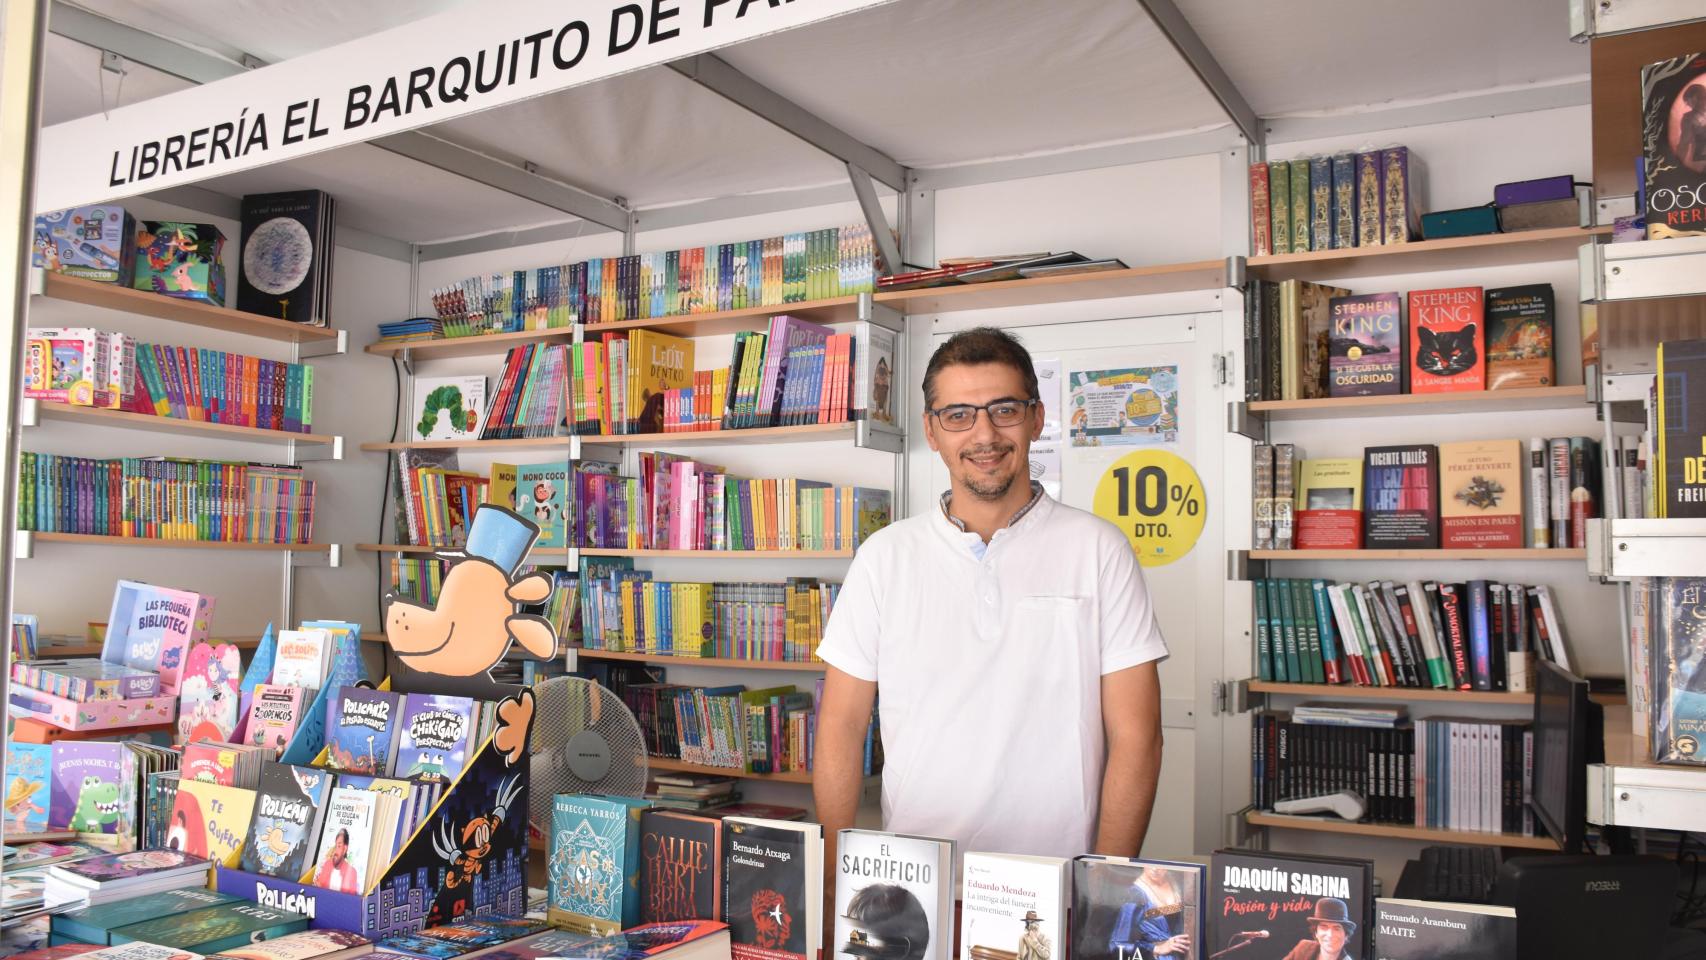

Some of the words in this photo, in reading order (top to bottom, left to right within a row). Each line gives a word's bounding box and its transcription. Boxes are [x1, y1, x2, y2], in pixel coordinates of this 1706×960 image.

[109, 107, 269, 188] LIBRERÍA
[281, 98, 329, 147] EL
[343, 20, 590, 132] BARQUITO
[607, 0, 680, 57] DE
[1411, 290, 1477, 307] STEPHEN
[1334, 301, 1392, 315] STEPHEN
[1418, 304, 1471, 326] KING
[1335, 314, 1393, 336] KING
[651, 344, 685, 368] LEÓN
[650, 367, 684, 383] DENTRO
[1355, 364, 1380, 372] GUSTA
[1383, 363, 1393, 371] LA
[1336, 373, 1394, 386] OSCURIDAD
[1370, 452, 1400, 466] VICENTE
[1401, 448, 1427, 465] VALLÉS
[499, 473, 516, 482] MON
[522, 473, 544, 482] MONO
[545, 472, 566, 481] COCO
[1112, 465, 1199, 517] 10%
[1678, 488, 1706, 502] FREI
[1444, 517, 1477, 527] MISIÓN
[1478, 517, 1490, 526] EN
[1491, 516, 1517, 526] PARÍS
[1134, 523, 1172, 538] DTO.
[145, 600, 159, 611] LAS
[211, 799, 223, 814] TE
[261, 794, 309, 824] POLICÁN
[556, 802, 588, 816] REBECCA
[590, 807, 620, 820] YARROS
[643, 831, 708, 875] CALLIE
[732, 841, 764, 856] Bernardo
[764, 847, 792, 862] Atxaga
[879, 842, 891, 857] EL
[732, 855, 765, 868] Golondrinas
[842, 854, 932, 884] SACRIFICIO
[967, 879, 1001, 892] Eduardo
[1001, 885, 1037, 898] Mendoza
[1223, 865, 1288, 893] JOAQUÍN
[1290, 871, 1351, 900] SABINA
[256, 881, 316, 919] POLICÁN
[967, 893, 976, 901] La
[976, 894, 998, 907] intriga
[999, 896, 1010, 906] del
[1011, 898, 1036, 910] funeral
[1223, 896, 1266, 918] Pasión
[1267, 901, 1280, 920] y
[1281, 896, 1313, 913] vida
[966, 903, 1013, 918] inconveniente
[1380, 910, 1420, 925] Fernando
[1421, 915, 1467, 930] Aramburu
[1380, 925, 1416, 939] MAITE
[1117, 944, 1144, 960] LA
